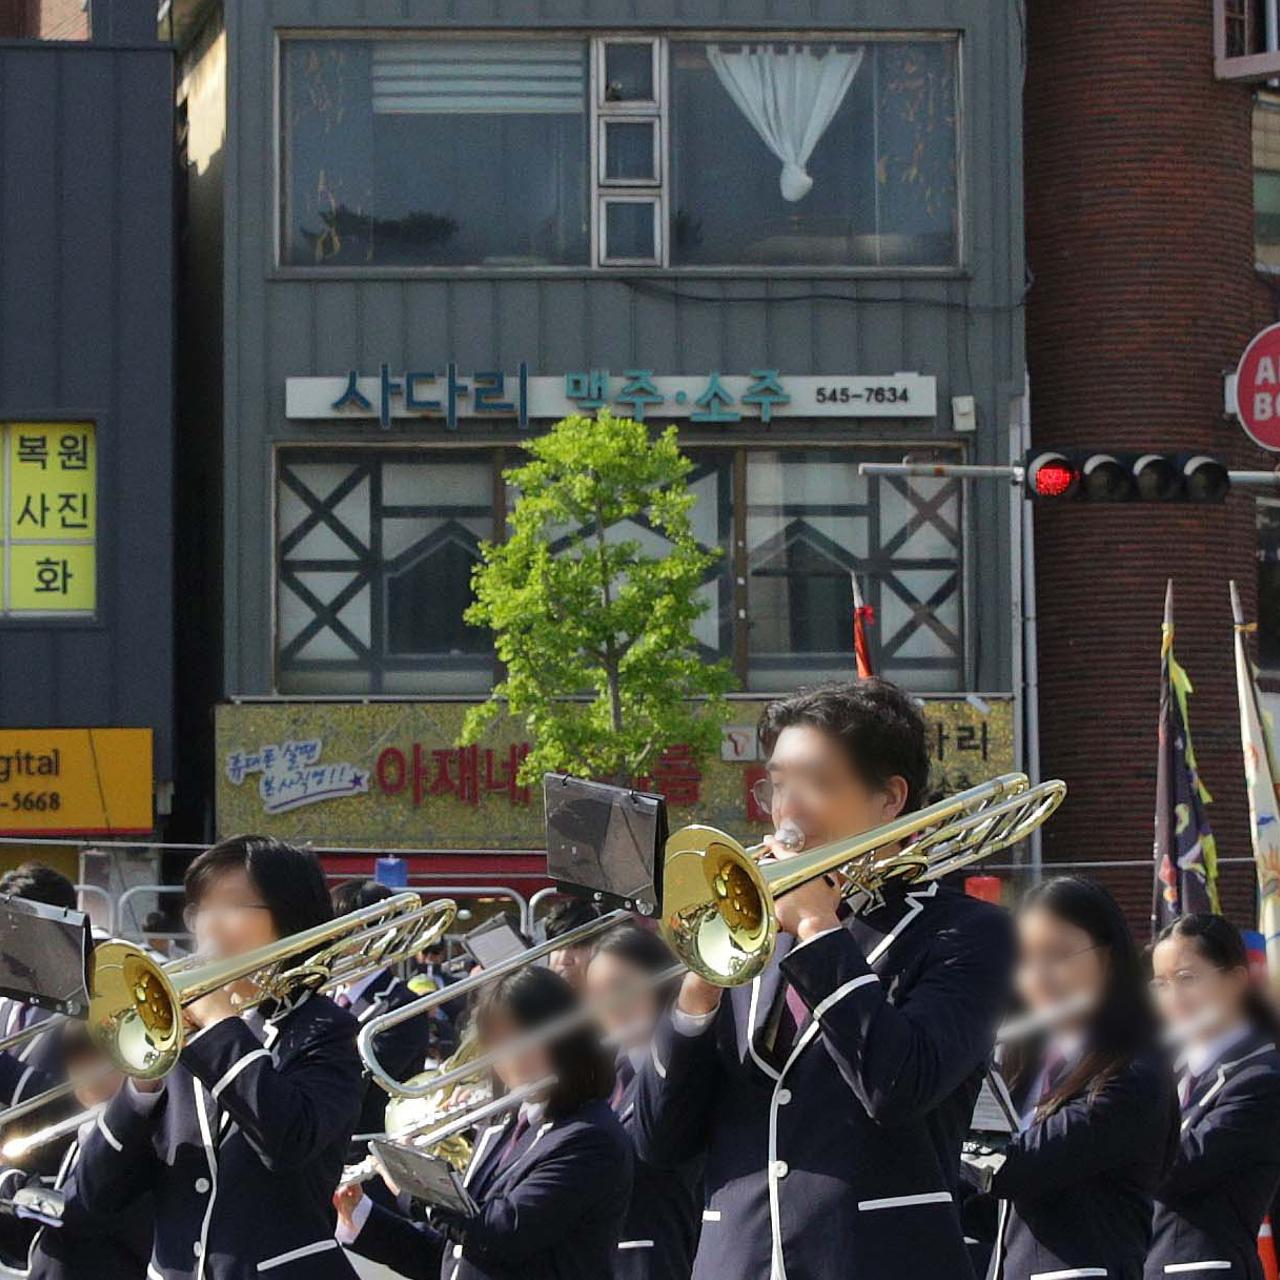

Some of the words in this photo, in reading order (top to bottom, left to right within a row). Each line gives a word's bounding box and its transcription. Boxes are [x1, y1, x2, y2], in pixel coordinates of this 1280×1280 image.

[332, 363, 528, 429] 사다리
[816, 385, 910, 405] 545-7634
[17, 434, 89, 472] 복원
[18, 493, 89, 530] 사진
